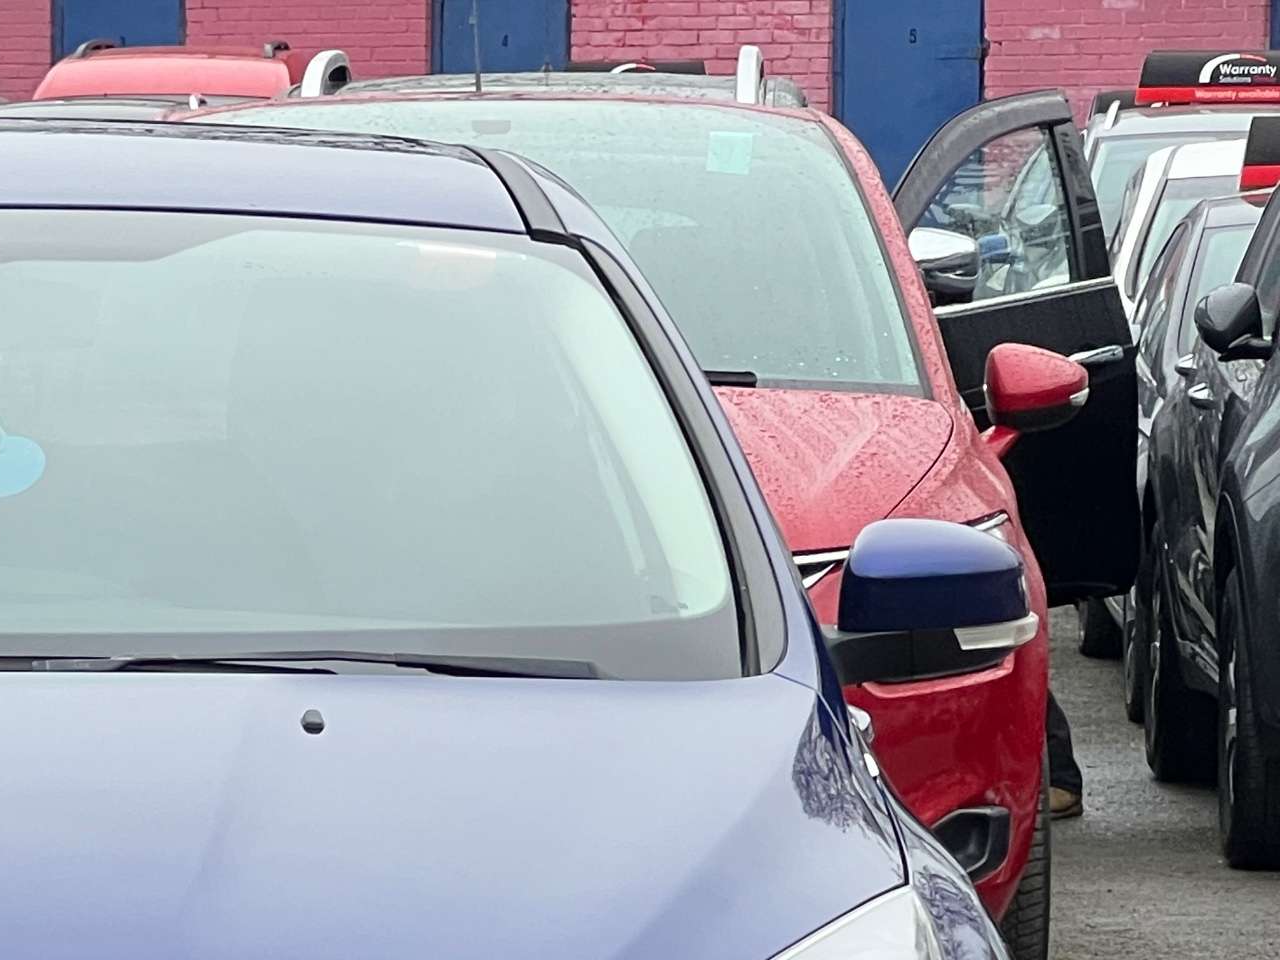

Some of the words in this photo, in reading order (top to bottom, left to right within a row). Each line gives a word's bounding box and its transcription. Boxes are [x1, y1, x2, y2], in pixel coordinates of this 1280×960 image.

[909, 28, 917, 44] 5
[1219, 64, 1277, 77] Warranty
[1194, 89, 1237, 100] Warranty
